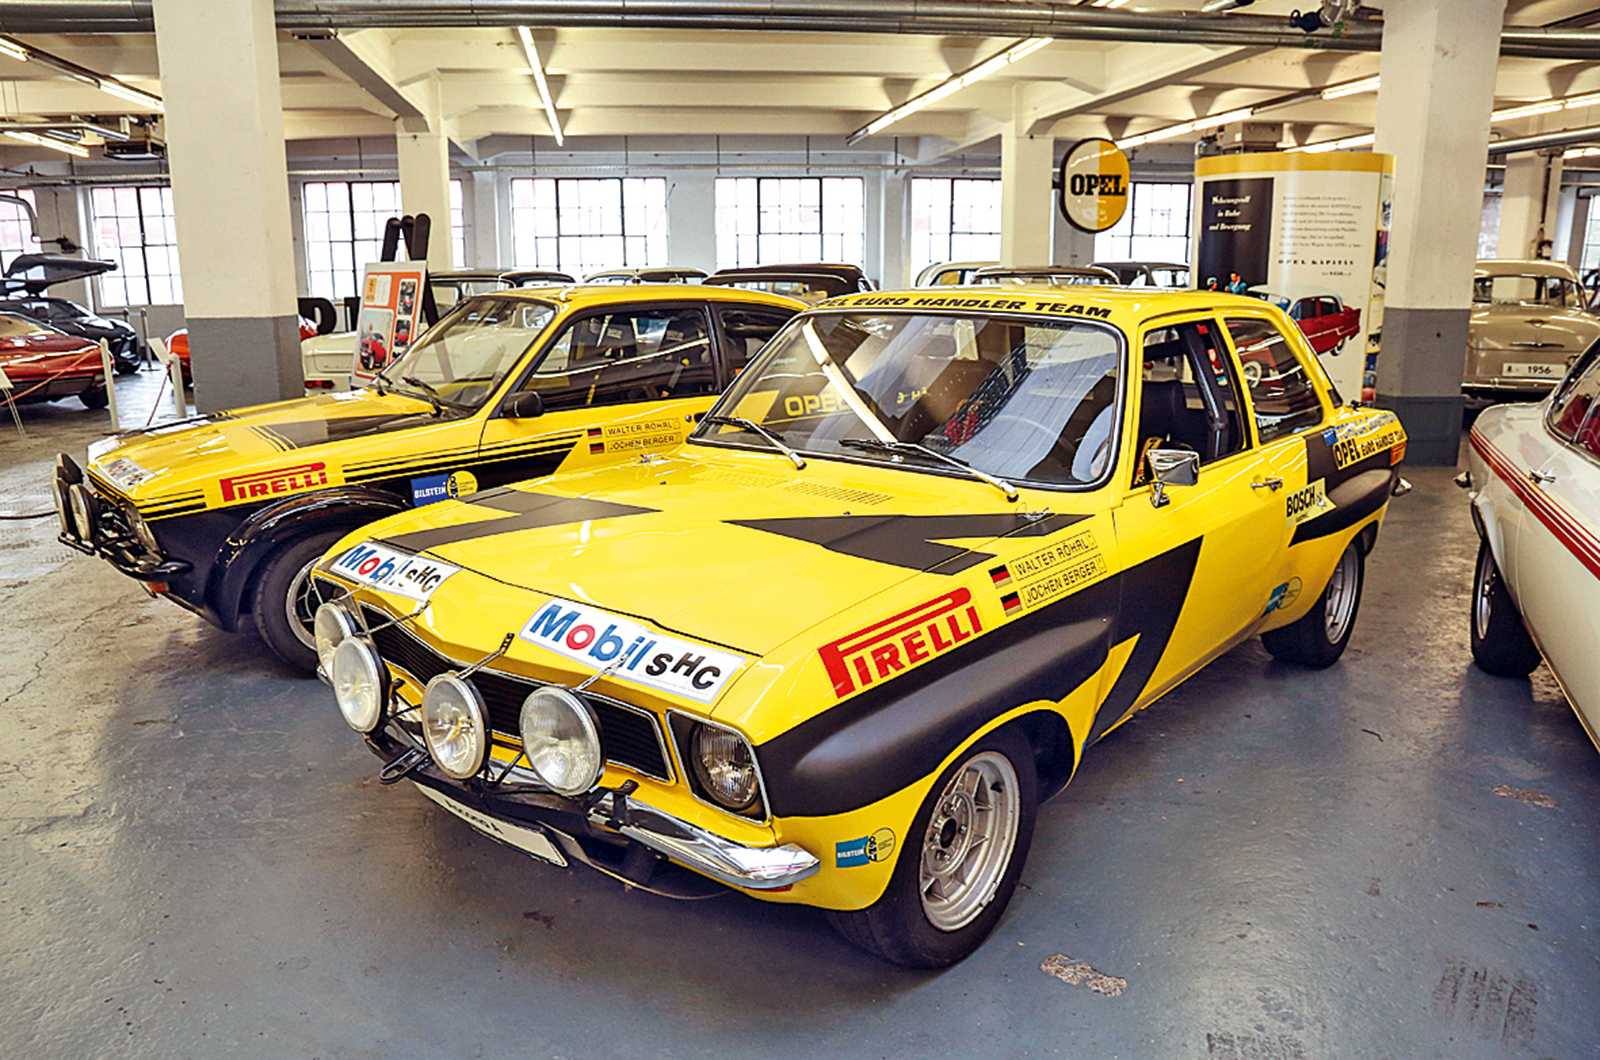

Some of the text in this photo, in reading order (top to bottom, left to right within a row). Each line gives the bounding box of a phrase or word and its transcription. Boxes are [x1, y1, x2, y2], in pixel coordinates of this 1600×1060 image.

[1071, 174, 1126, 196] OPEL
[853, 297, 910, 306] EURO
[1035, 302, 1112, 319] TEAM
[1528, 366, 1552, 375] 1956
[608, 424, 643, 436] WALTER
[609, 435, 675, 451] JOCHEN BERGER
[1333, 438, 1361, 467] OPEL
[219, 461, 328, 503] PIRELLI
[1286, 485, 1316, 518] BOSCH
[1014, 537, 1090, 576] WALTER RÖHRL
[1025, 560, 1097, 603] JOCHEN BERGER
[529, 604, 722, 690] Mobil SHC
[816, 587, 983, 699] PIRELLI
